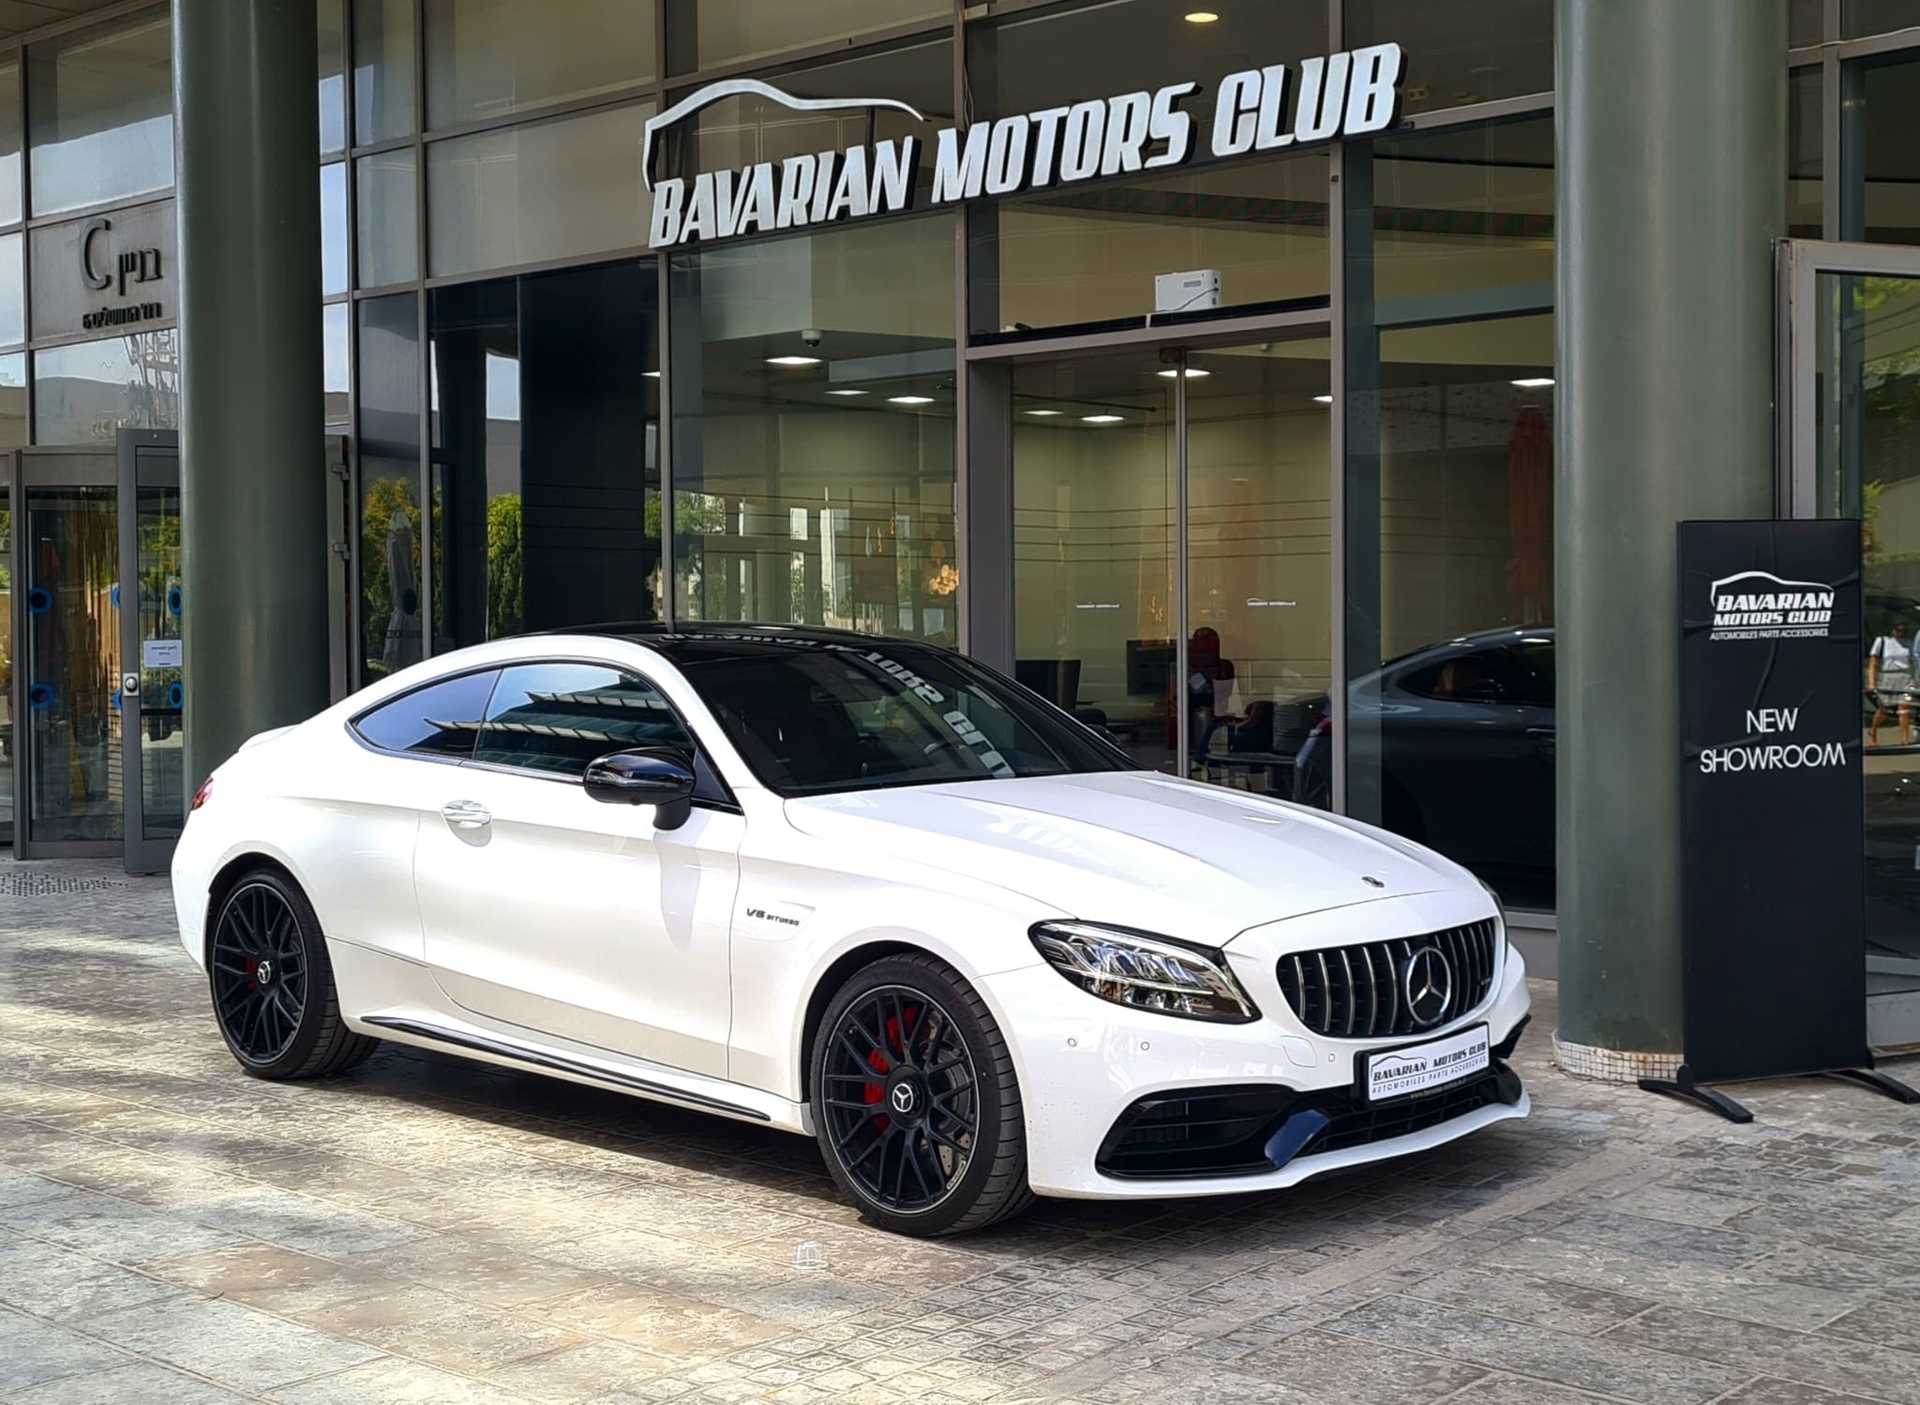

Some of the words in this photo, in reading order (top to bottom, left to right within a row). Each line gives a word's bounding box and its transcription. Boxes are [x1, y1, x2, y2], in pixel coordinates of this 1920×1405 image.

[648, 136, 912, 248] BAVARIAN
[931, 81, 1198, 204] MOTORS
[1211, 42, 1402, 157] CLUB
[79, 219, 112, 291] C
[1716, 592, 1835, 612] BAVARIAN
[1713, 612, 1784, 626] MOTORS
[1787, 610, 1832, 624] CLUB
[1709, 630, 1758, 641] AUTOMOBILES
[1759, 629, 1780, 639] PARTS
[1780, 628, 1829, 638] ACCESSORIES
[1746, 707, 1798, 734] NEW
[1700, 742, 1846, 773] SHOWROOM
[746, 908, 766, 919] V8
[766, 914, 800, 926] BITURBO
[1373, 1062, 1427, 1082] BAVARIAN
[1432, 1048, 1467, 1068] MOTORS
[1468, 1041, 1487, 1056] CLUB
[1372, 1075, 1426, 1094] AUTOMOBILES
[1429, 1069, 1448, 1080] PARTS
